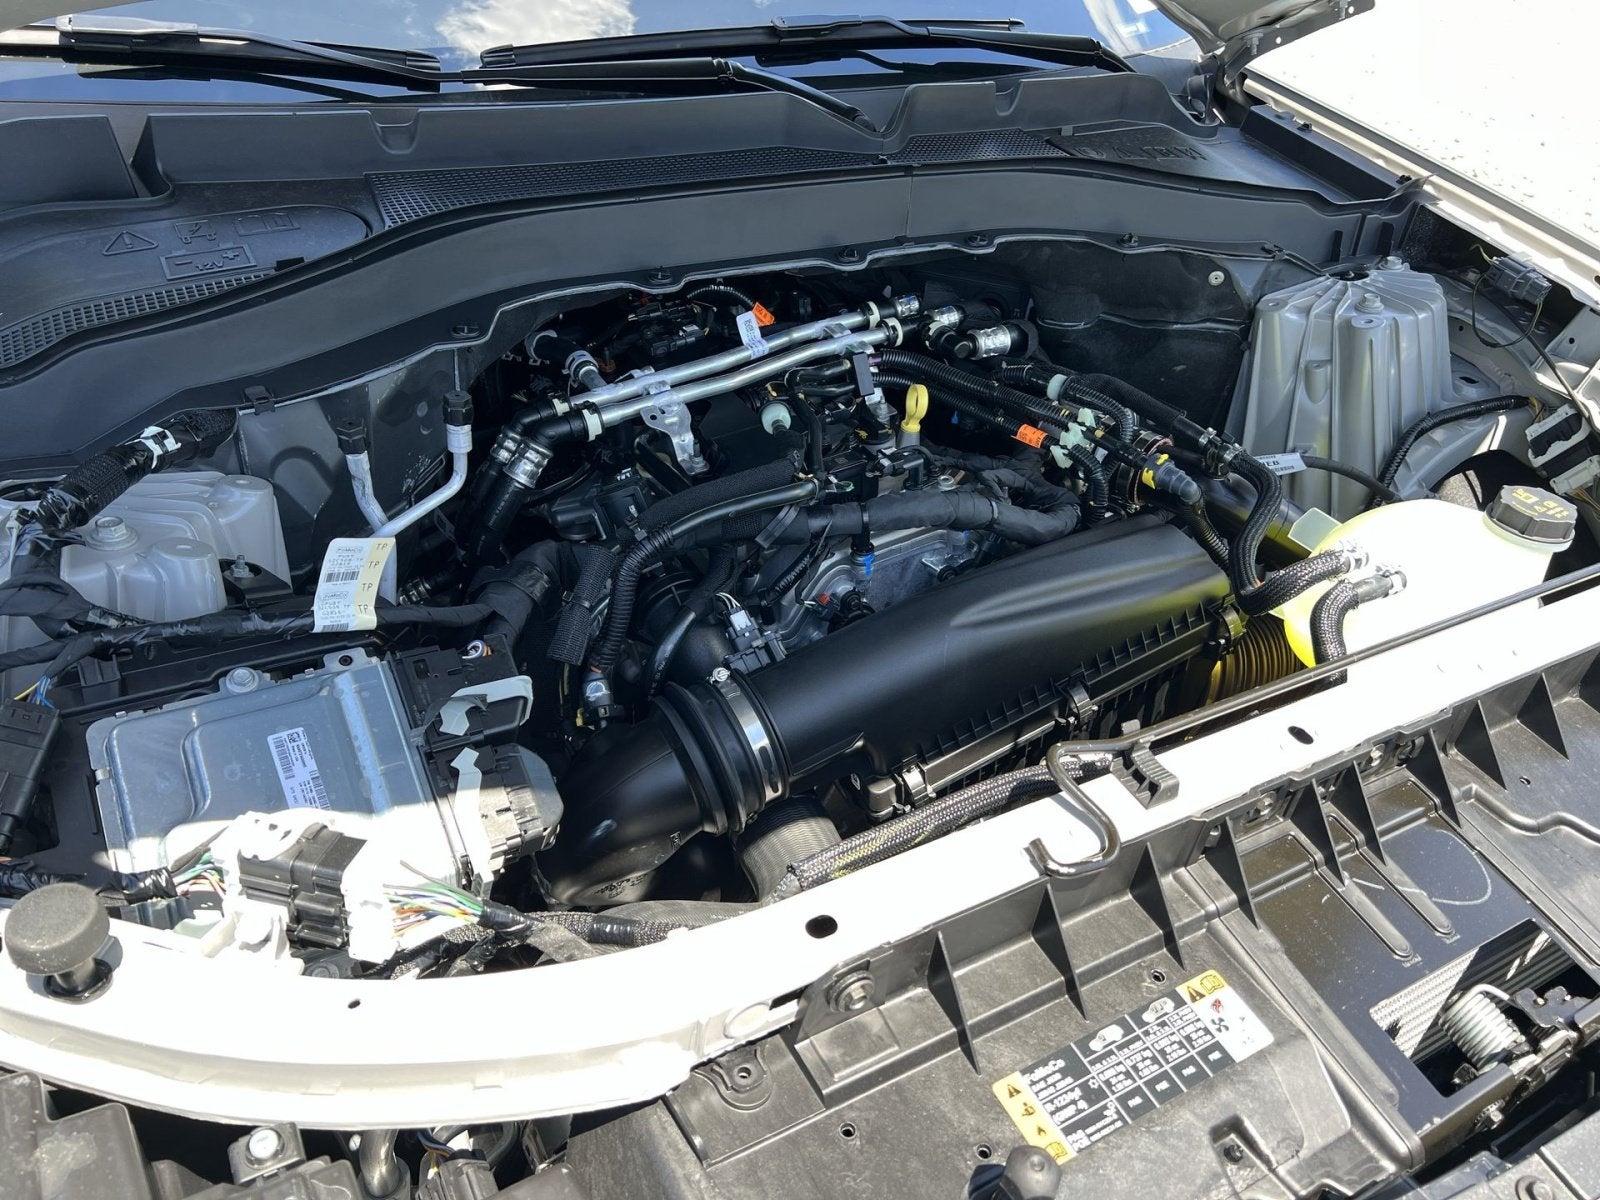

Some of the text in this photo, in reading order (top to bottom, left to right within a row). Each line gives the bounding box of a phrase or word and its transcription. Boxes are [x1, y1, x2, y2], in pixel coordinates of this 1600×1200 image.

[195, 260, 224, 271] 12V
[376, 543, 388, 551] TP
[368, 560, 380, 569] TP
[361, 582, 374, 592] TP
[357, 603, 369, 614] TP
[1022, 1060, 1064, 1084] FoMoCo
[1043, 1088, 1081, 1113] R-1234yf
